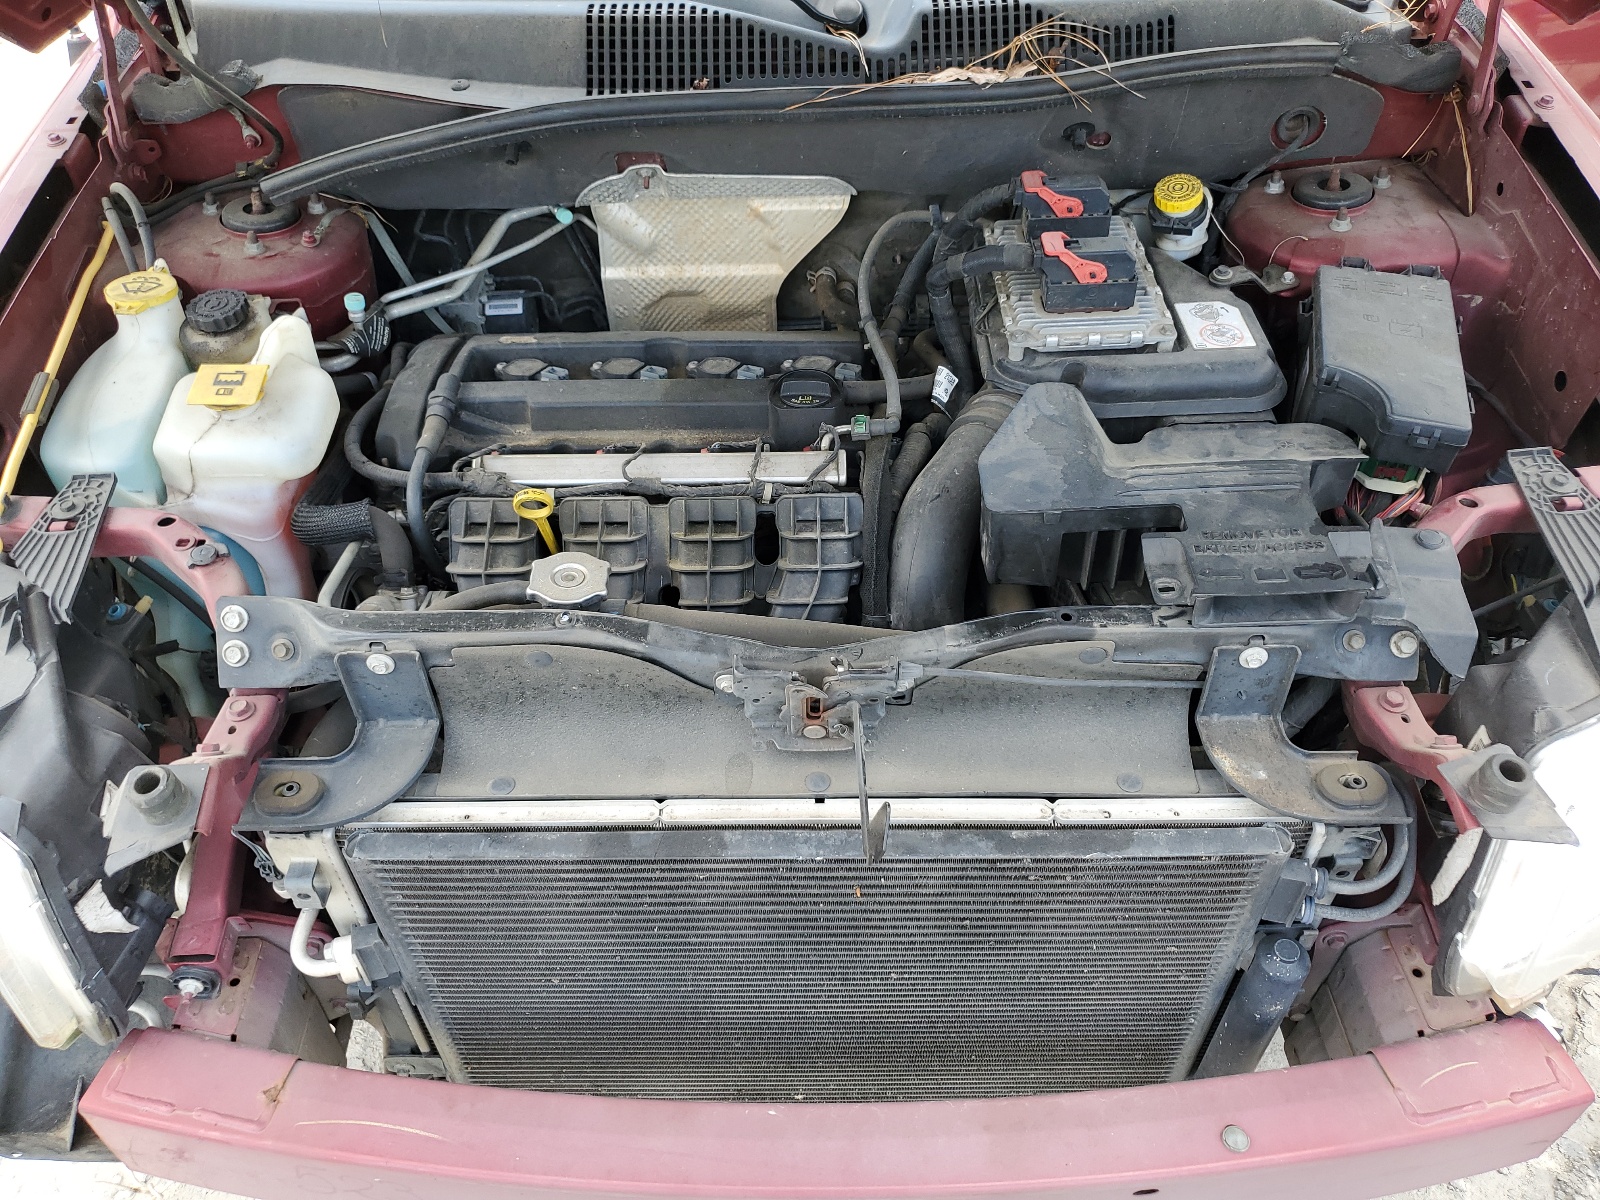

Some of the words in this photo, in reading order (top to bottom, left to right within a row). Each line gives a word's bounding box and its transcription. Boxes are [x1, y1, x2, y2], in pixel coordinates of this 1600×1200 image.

[1200, 529, 1265, 541] REMOVE
[1268, 527, 1303, 539] FOR
[1192, 543, 1259, 555] BATTERY
[1264, 540, 1327, 553] ACCESS
